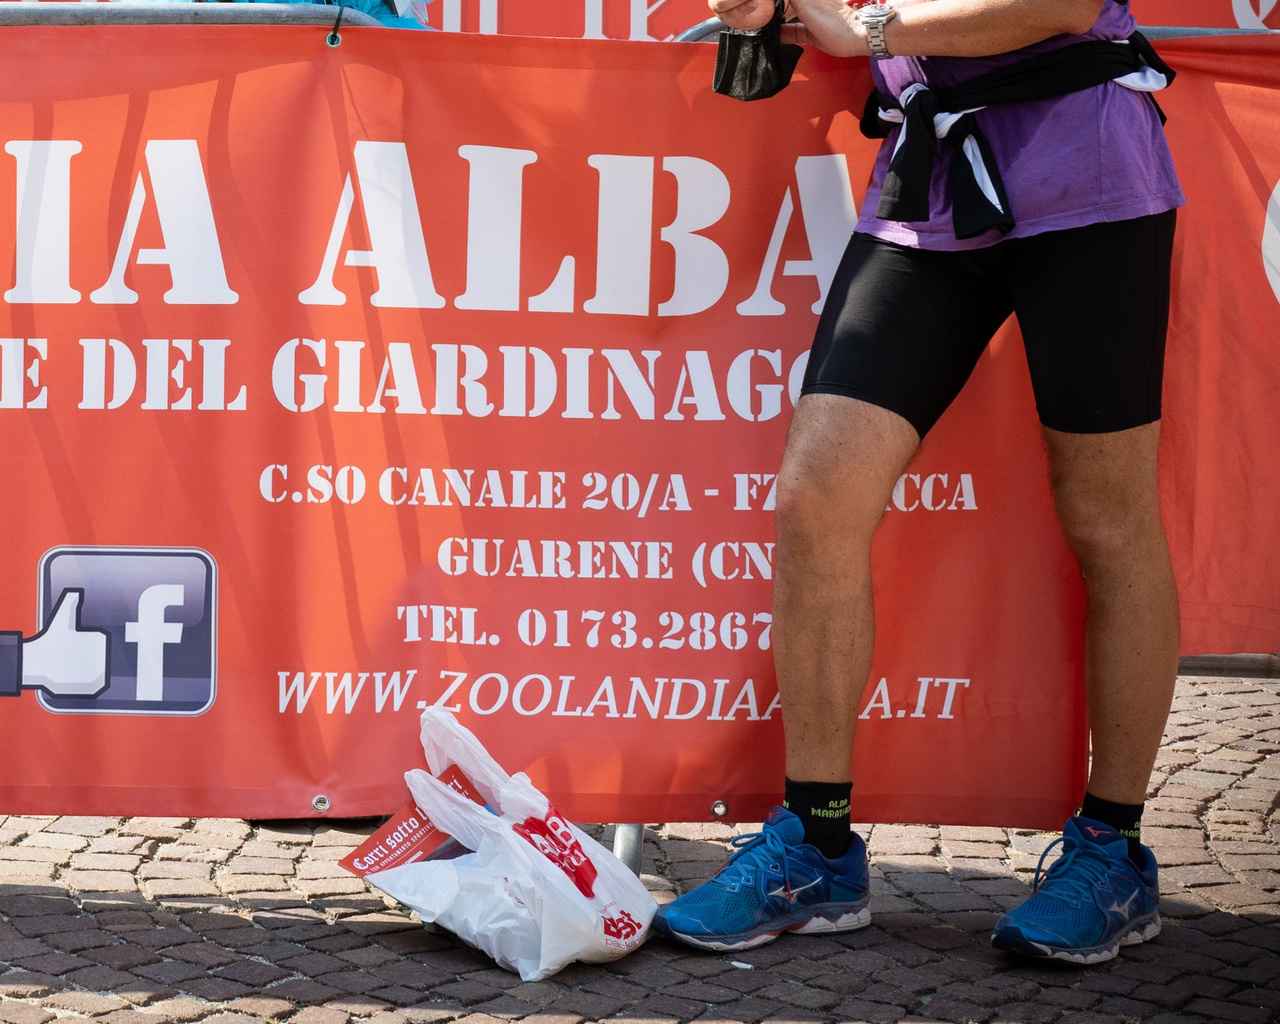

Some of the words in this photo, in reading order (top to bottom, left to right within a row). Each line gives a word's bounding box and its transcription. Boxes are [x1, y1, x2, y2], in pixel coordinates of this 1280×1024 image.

[298, 140, 858, 317] ALBA
[78, 338, 247, 411] DEL
[260, 464, 366, 504] C.SO
[379, 467, 566, 511] CANALE
[582, 472, 692, 518] 20/A
[438, 537, 673, 579] GUARENE
[397, 605, 500, 645] TEL.
[352, 840, 385, 872] Corri
[386, 817, 419, 848] sotto
